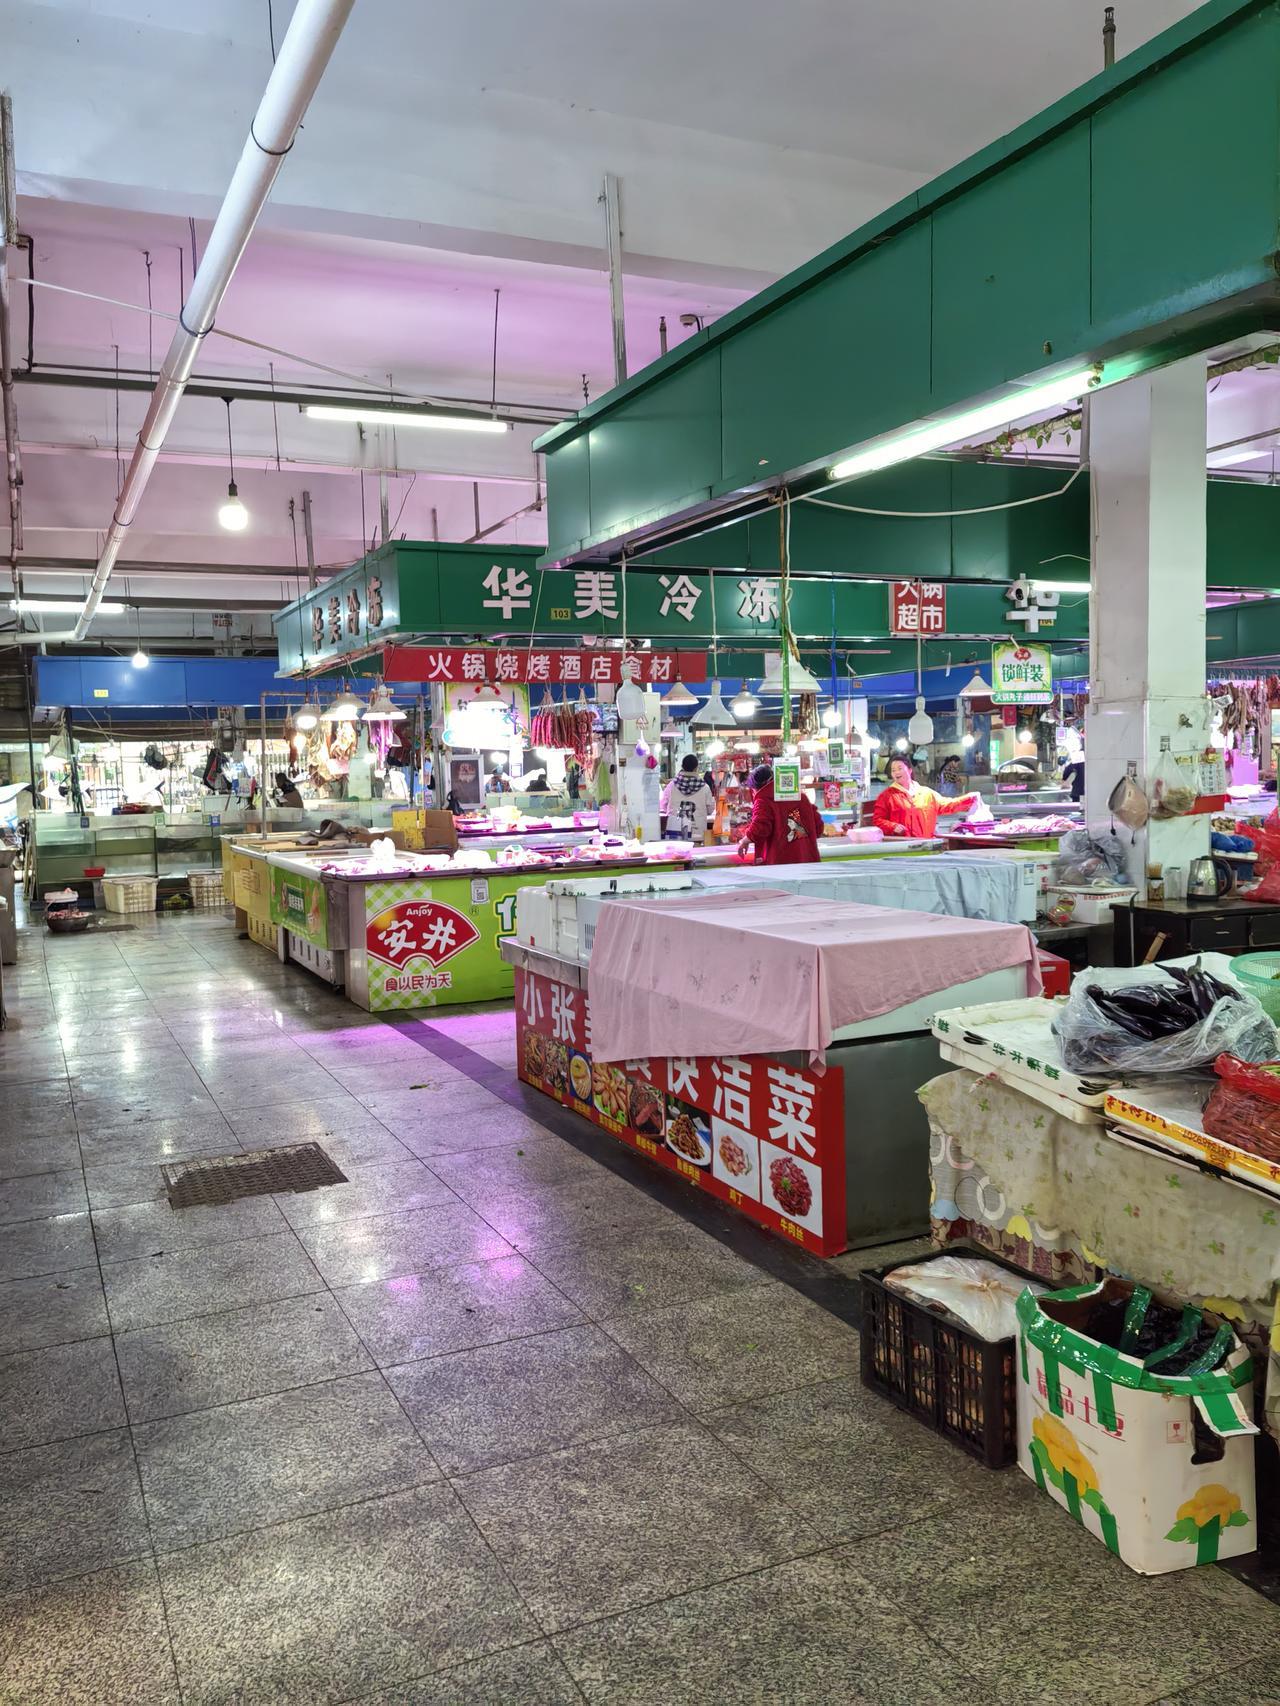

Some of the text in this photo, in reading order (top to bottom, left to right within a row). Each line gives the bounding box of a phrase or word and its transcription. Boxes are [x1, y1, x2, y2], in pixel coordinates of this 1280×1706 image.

[483, 565, 780, 623] 华美冷冻
[897, 582, 943, 600] 火锅
[553, 610, 570, 619] 103
[897, 603, 943, 631] 超市
[428, 651, 672, 681] 火锅烧烤酒店食材
[406, 904, 433, 917] Anjoy
[378, 917, 457, 958] 安井
[385, 972, 451, 992] 食以民为天
